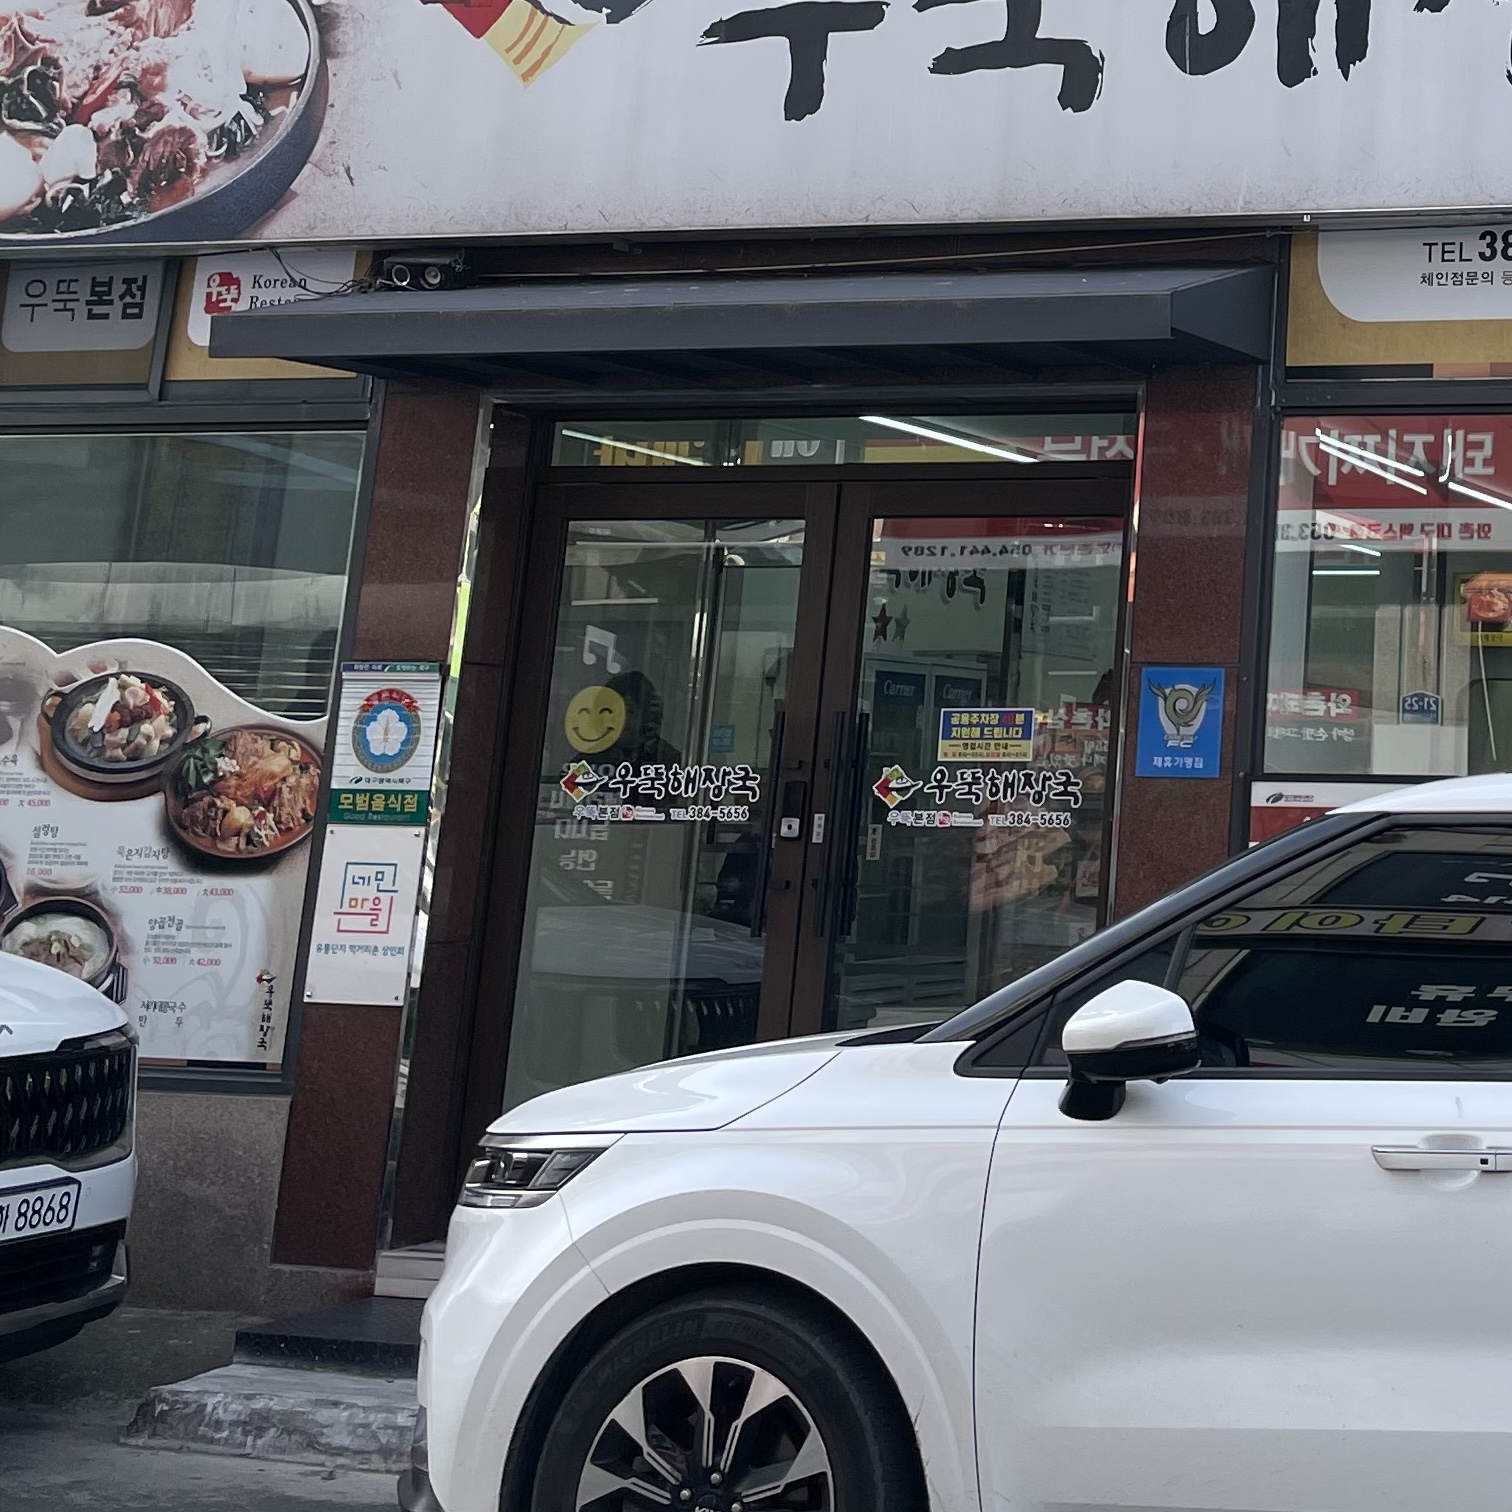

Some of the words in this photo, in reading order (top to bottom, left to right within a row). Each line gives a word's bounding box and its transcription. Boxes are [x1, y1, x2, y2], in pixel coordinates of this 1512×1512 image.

[1422, 240, 1473, 264] TEL
[251, 274, 307, 289] Korean
[1419, 268, 1495, 287] 체인점문의
[19, 274, 148, 323] 우뚝본점
[983, 727, 1022, 738] 드립니다
[1152, 756, 1204, 769] 제휴가맹점
[609, 761, 762, 803] 우뚝해장국
[924, 766, 1083, 808] 우뚝해장국
[337, 792, 419, 813] 모범음식점
[573, 805, 621, 821] 우뚝본점
[688, 805, 750, 822] 384-5656
[887, 810, 938, 827] 우뚝본점
[1008, 811, 1072, 829] 384-5656
[14, 1190, 71, 1232] 8868
